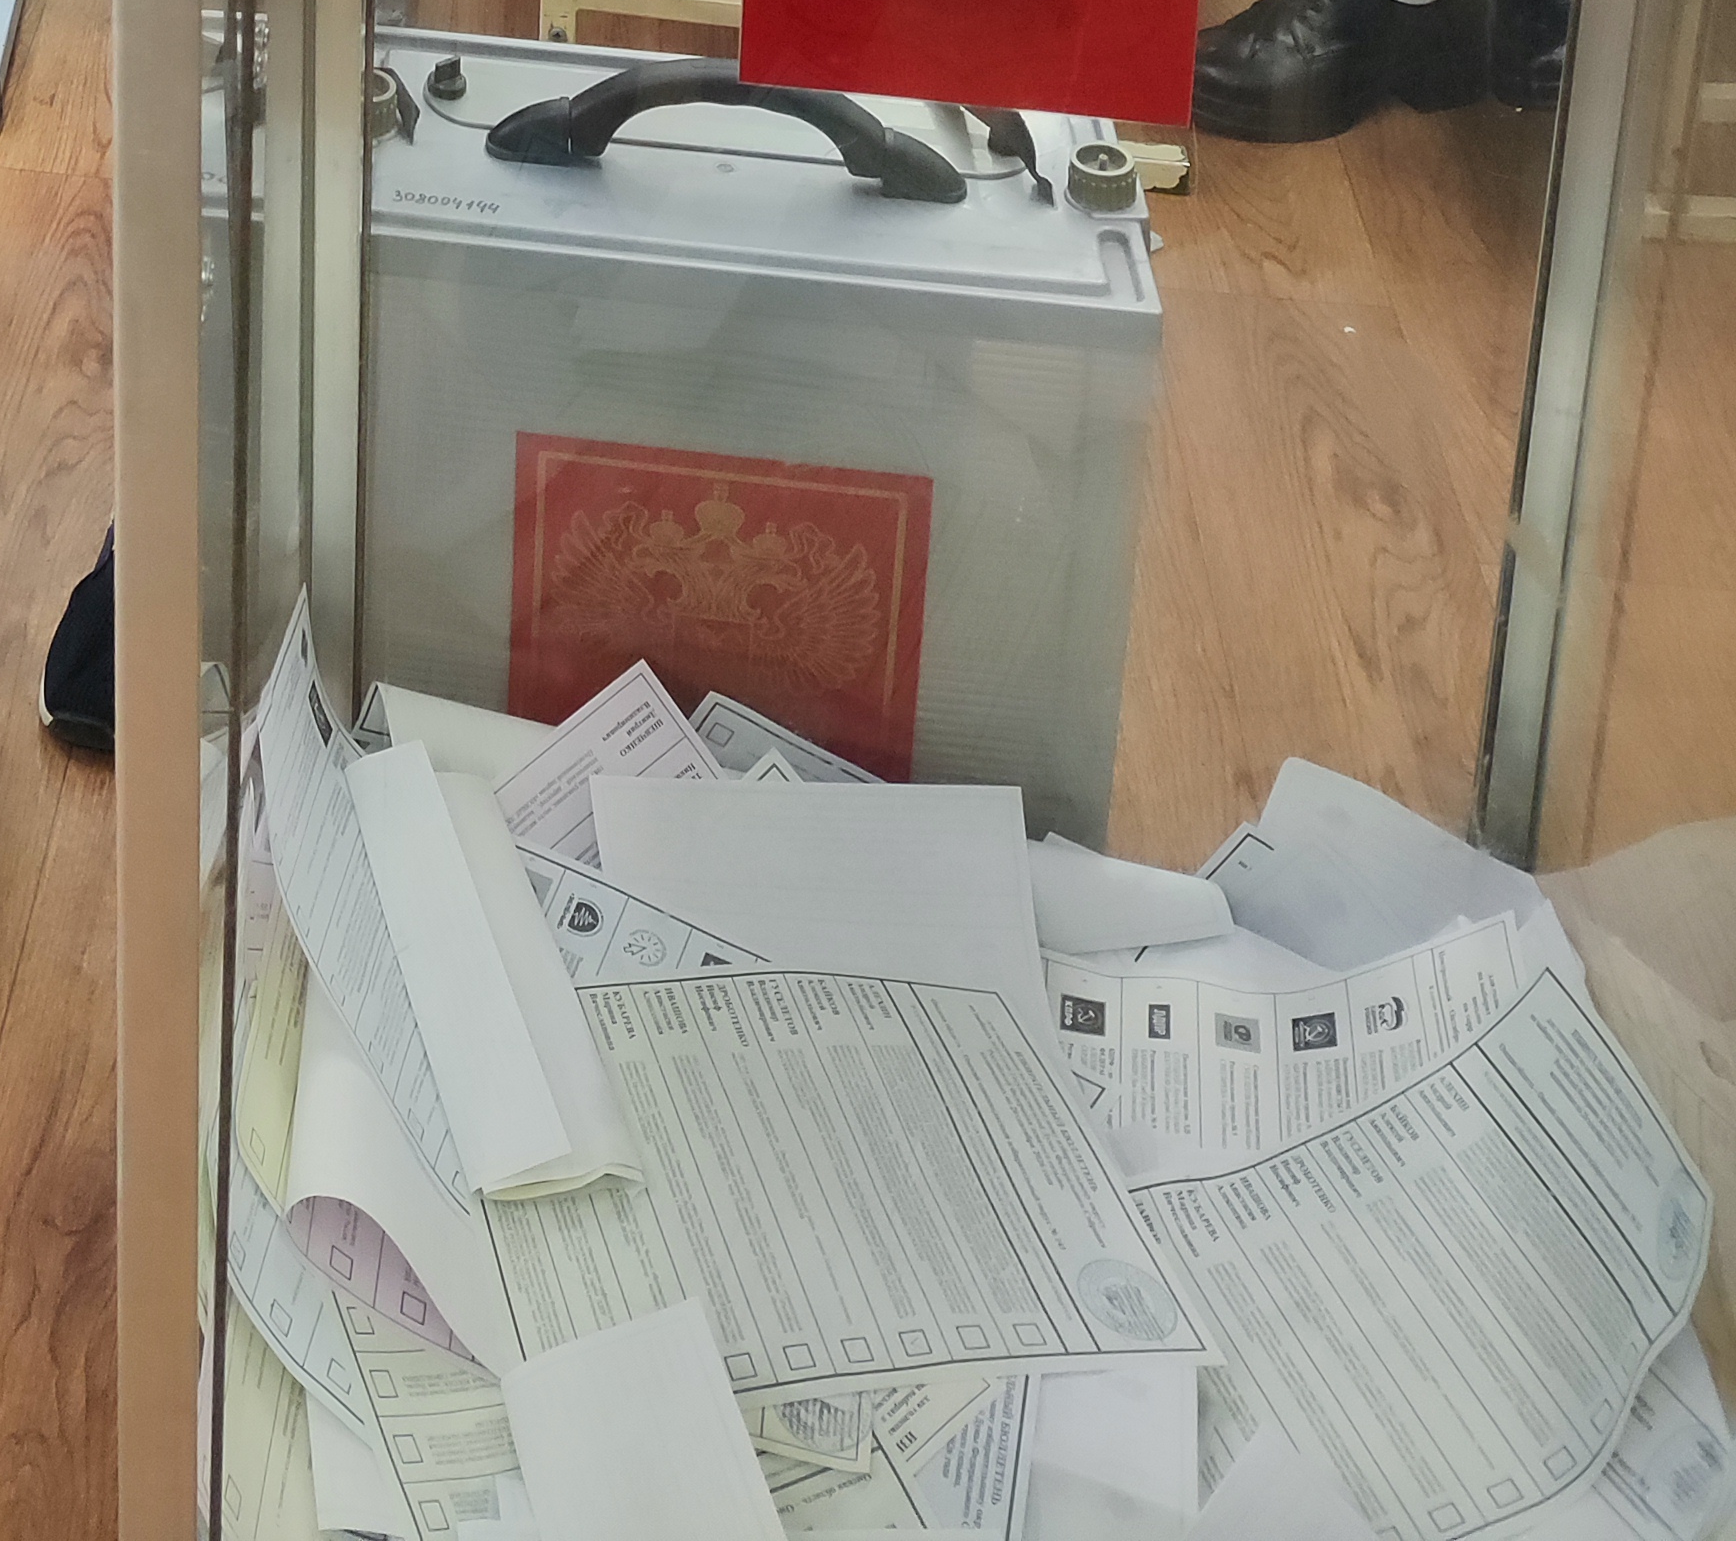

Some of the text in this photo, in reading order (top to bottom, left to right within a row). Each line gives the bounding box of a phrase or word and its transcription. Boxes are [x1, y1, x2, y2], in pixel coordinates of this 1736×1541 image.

[612, 990, 637, 1039] КУБАРЕВА
[1064, 999, 1072, 1025] КПРФ
[992, 1421, 1011, 1503] БЮЛЛЕТЕНЬ
